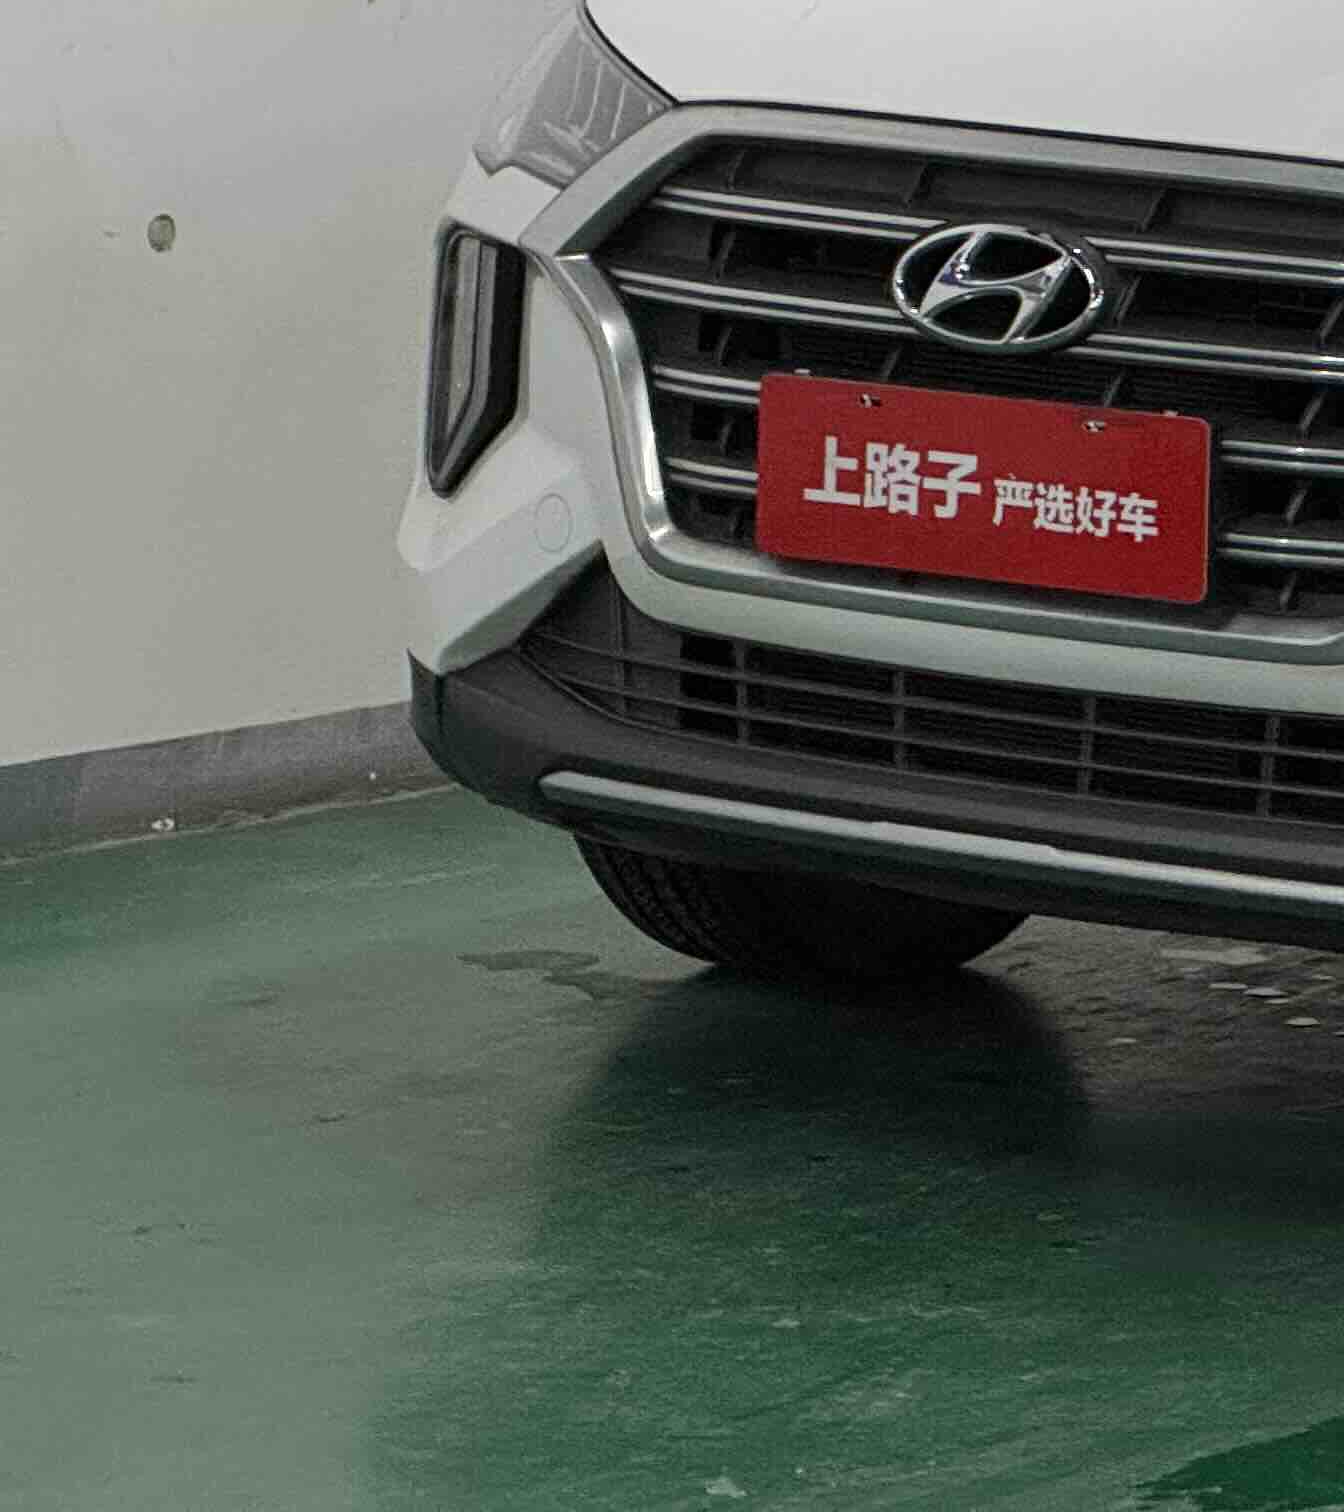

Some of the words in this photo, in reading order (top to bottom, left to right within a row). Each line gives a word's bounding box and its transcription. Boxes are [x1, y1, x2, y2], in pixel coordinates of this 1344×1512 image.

[804, 436, 981, 519] 上路子
[993, 474, 1158, 542] 严选好车
